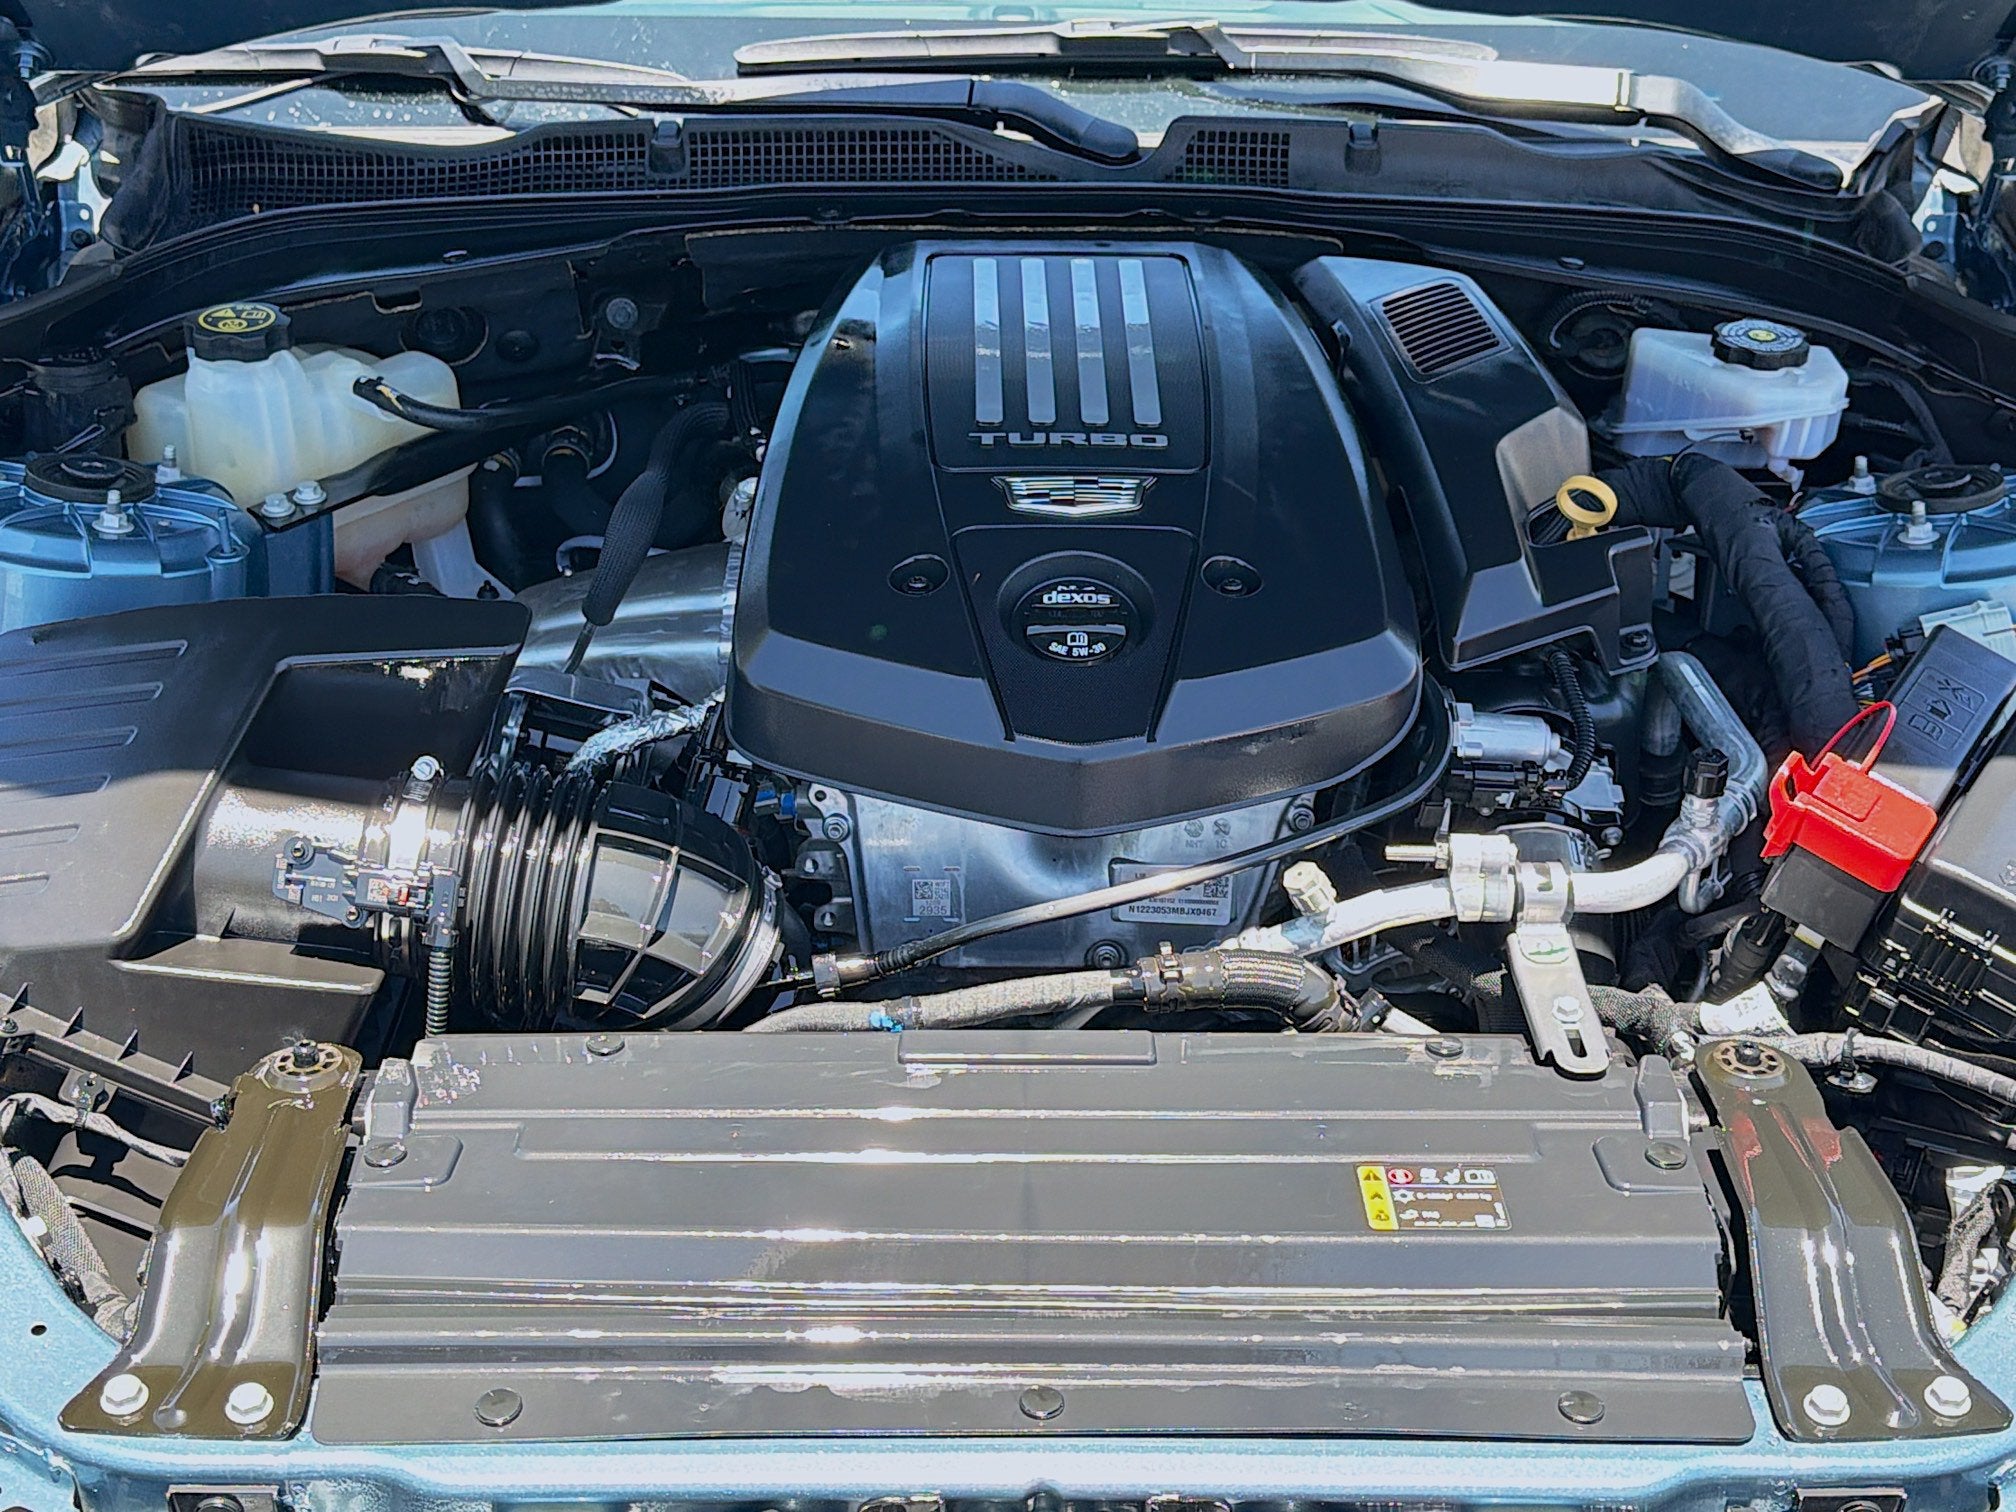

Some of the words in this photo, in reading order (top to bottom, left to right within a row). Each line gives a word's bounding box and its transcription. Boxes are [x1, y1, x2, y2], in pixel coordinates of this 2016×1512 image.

[968, 432, 1169, 448] TURBO
[1043, 590, 1111, 604] dexos
[1048, 641, 1069, 655] SAE
[1071, 642, 1107, 657] 5W-30
[919, 905, 947, 915] 2935
